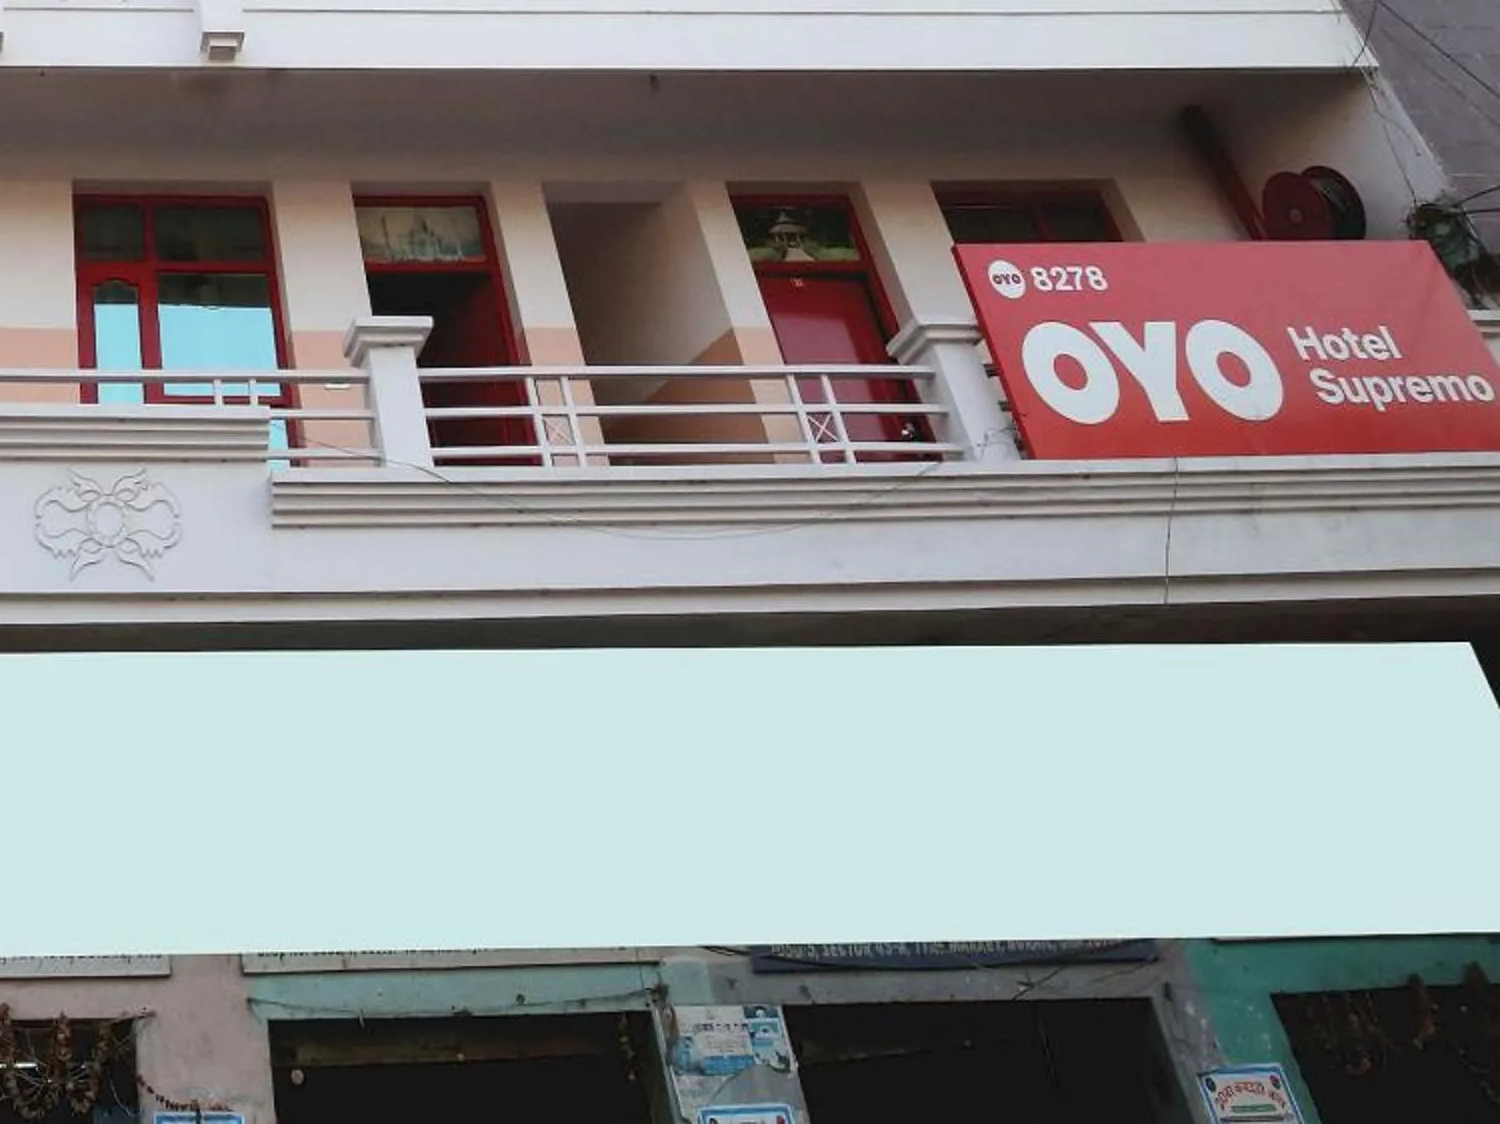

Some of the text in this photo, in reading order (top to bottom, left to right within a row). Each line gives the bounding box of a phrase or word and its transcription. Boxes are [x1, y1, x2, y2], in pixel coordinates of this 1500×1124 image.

[992, 265, 1109, 291] OYO 8278
[1286, 325, 1402, 361] Hotel
[1021, 319, 1284, 425] OYO
[1309, 368, 1496, 411] Supremo
